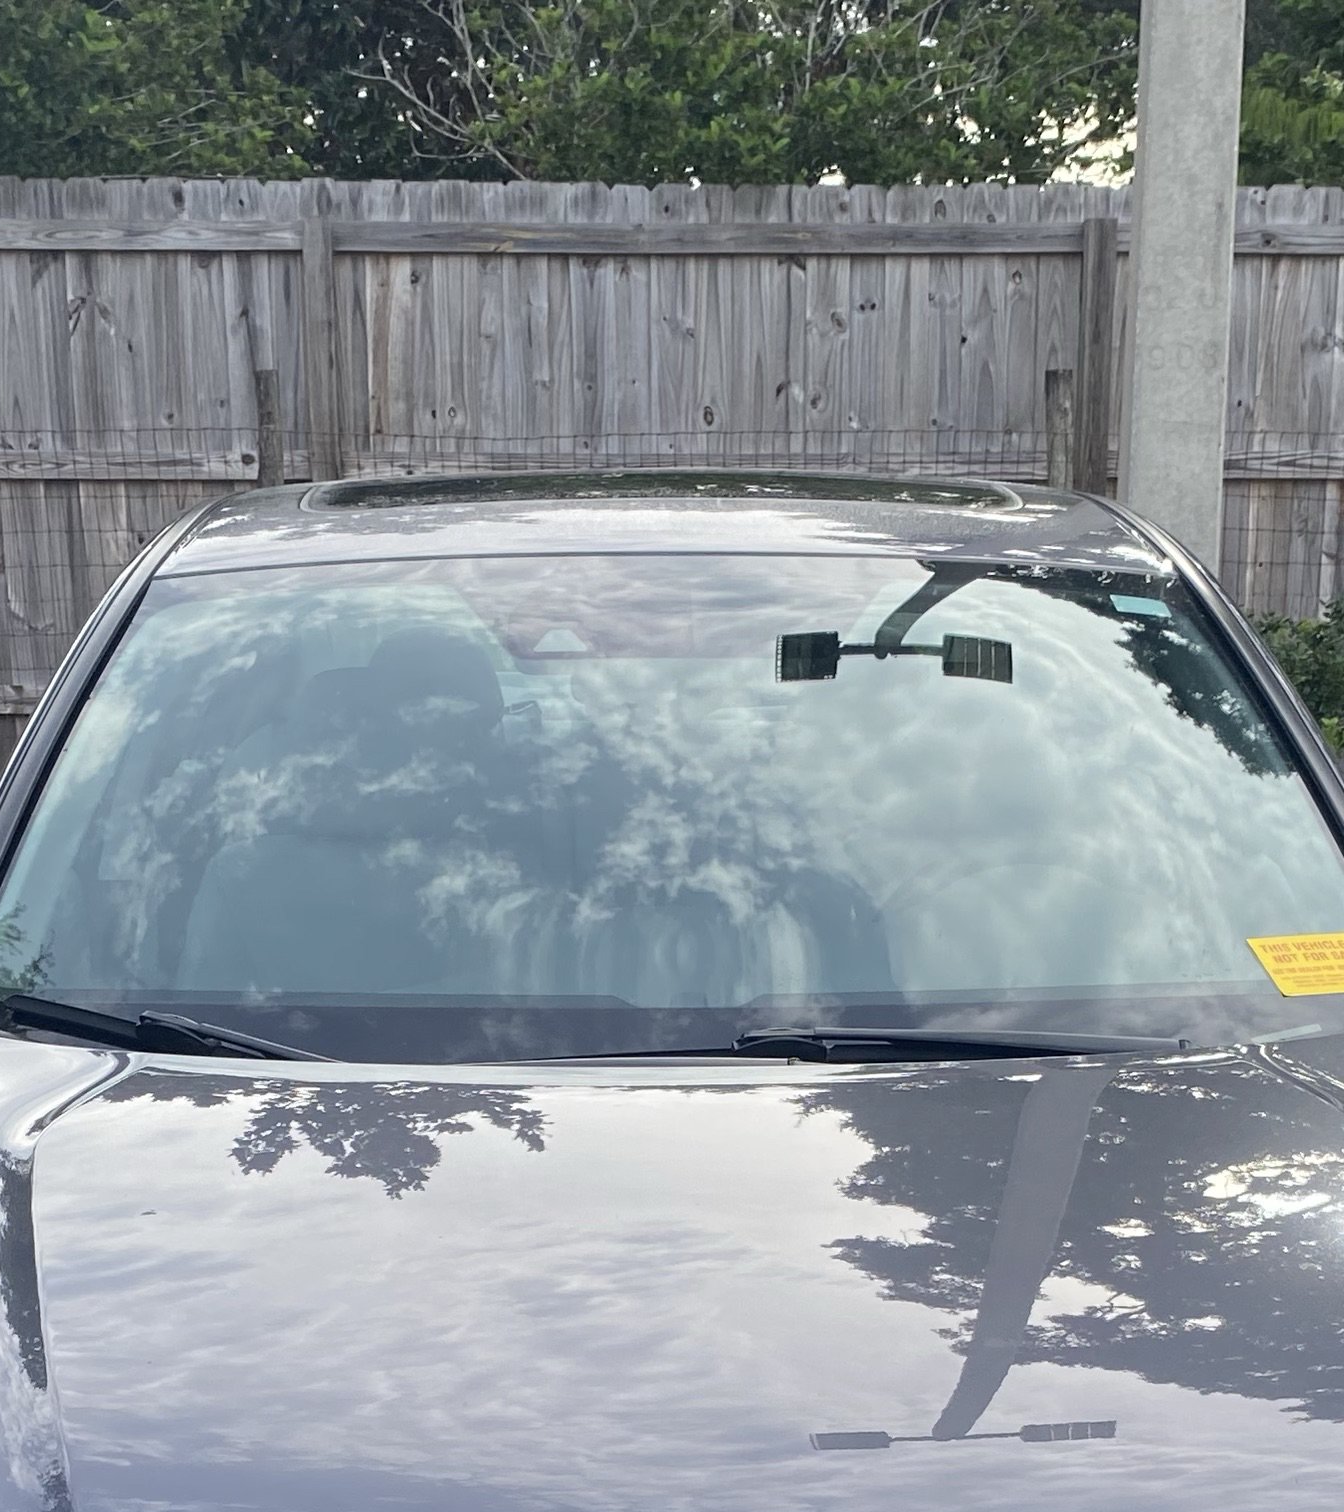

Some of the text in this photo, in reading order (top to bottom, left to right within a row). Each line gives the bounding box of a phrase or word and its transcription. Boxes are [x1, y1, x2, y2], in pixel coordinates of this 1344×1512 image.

[1259, 943, 1290, 953] THIS
[1272, 954, 1299, 964] NOT
[1303, 952, 1329, 962] FOR
